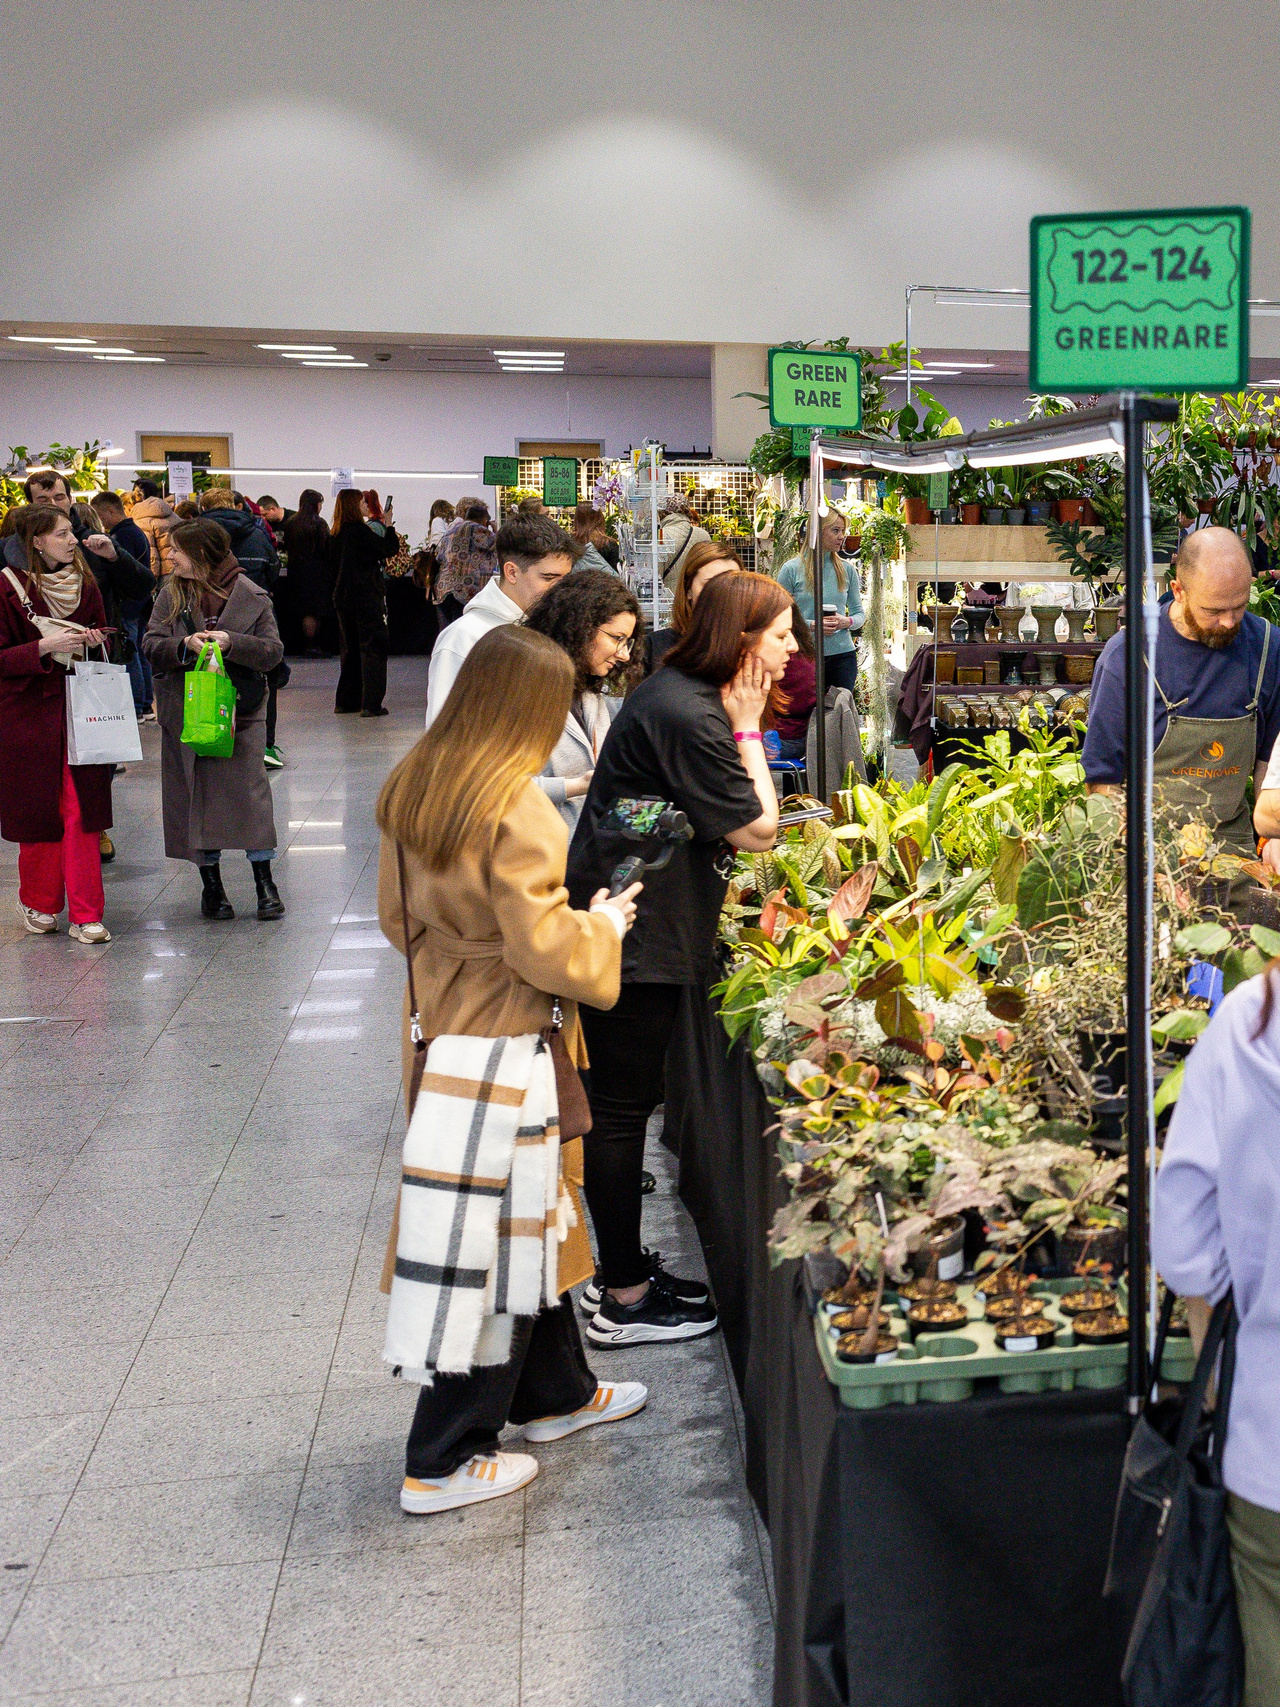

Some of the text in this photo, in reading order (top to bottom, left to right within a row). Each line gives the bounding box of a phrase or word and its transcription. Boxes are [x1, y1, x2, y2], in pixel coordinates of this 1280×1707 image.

[1072, 246, 1212, 284] 122-124
[1055, 324, 1228, 350] GREENRARE
[787, 363, 847, 383] GREEN
[794, 389, 841, 408] RARE
[550, 467, 570, 478] 85-86
